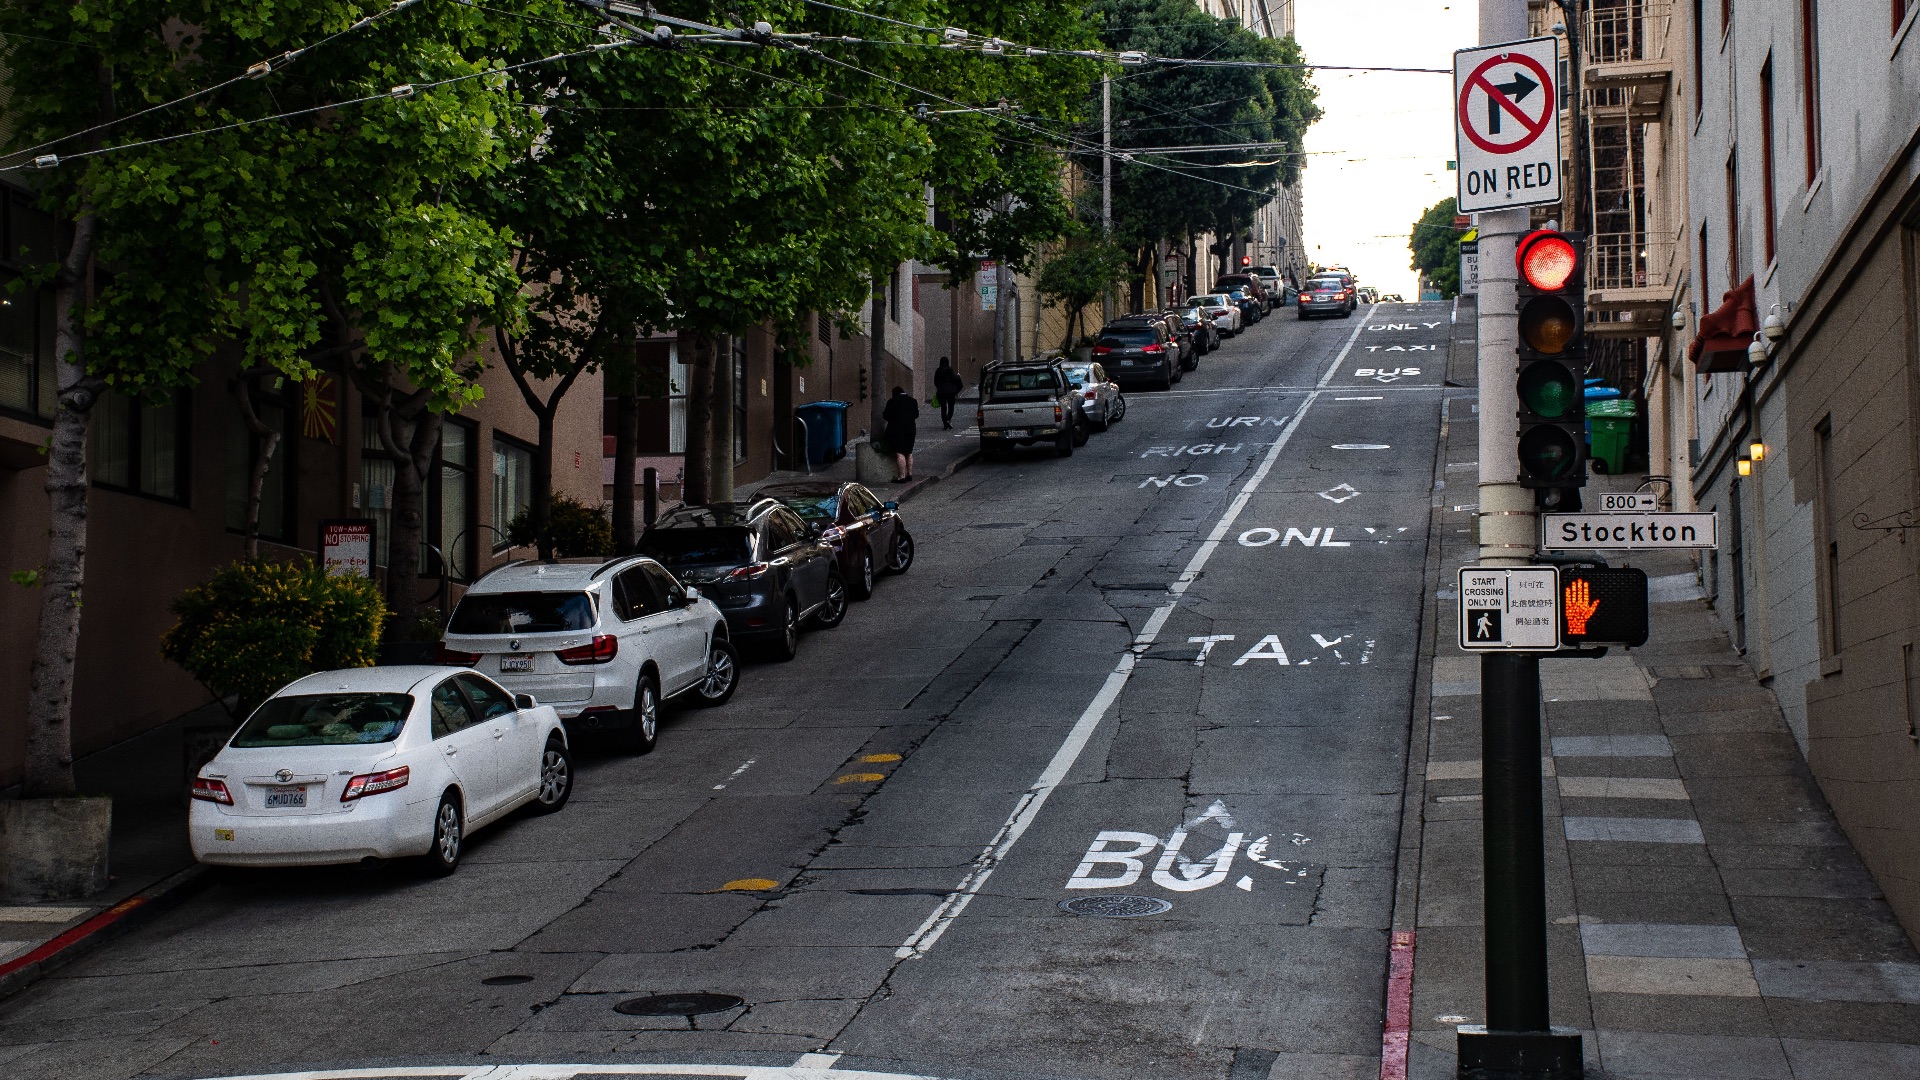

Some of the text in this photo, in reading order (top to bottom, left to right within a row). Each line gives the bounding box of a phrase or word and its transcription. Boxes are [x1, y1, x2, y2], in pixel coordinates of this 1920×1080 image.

[1467, 162, 1552, 196] ON RED
[1467, 256, 1478, 264] BU
[1367, 321, 1441, 331] ONLY
[1365, 344, 1436, 352] TAXI
[1354, 367, 1421, 377] BUS
[1137, 474, 1210, 489] NO
[1606, 495, 1637, 509] 800
[1561, 521, 1697, 542] Stockton
[325, 534, 369, 544] NO STOPPING
[1471, 577, 1497, 586] START
[1464, 588, 1504, 596] CROSSING
[1467, 598, 1501, 607] ONLY ON
[267, 793, 304, 806] 6MUD766
